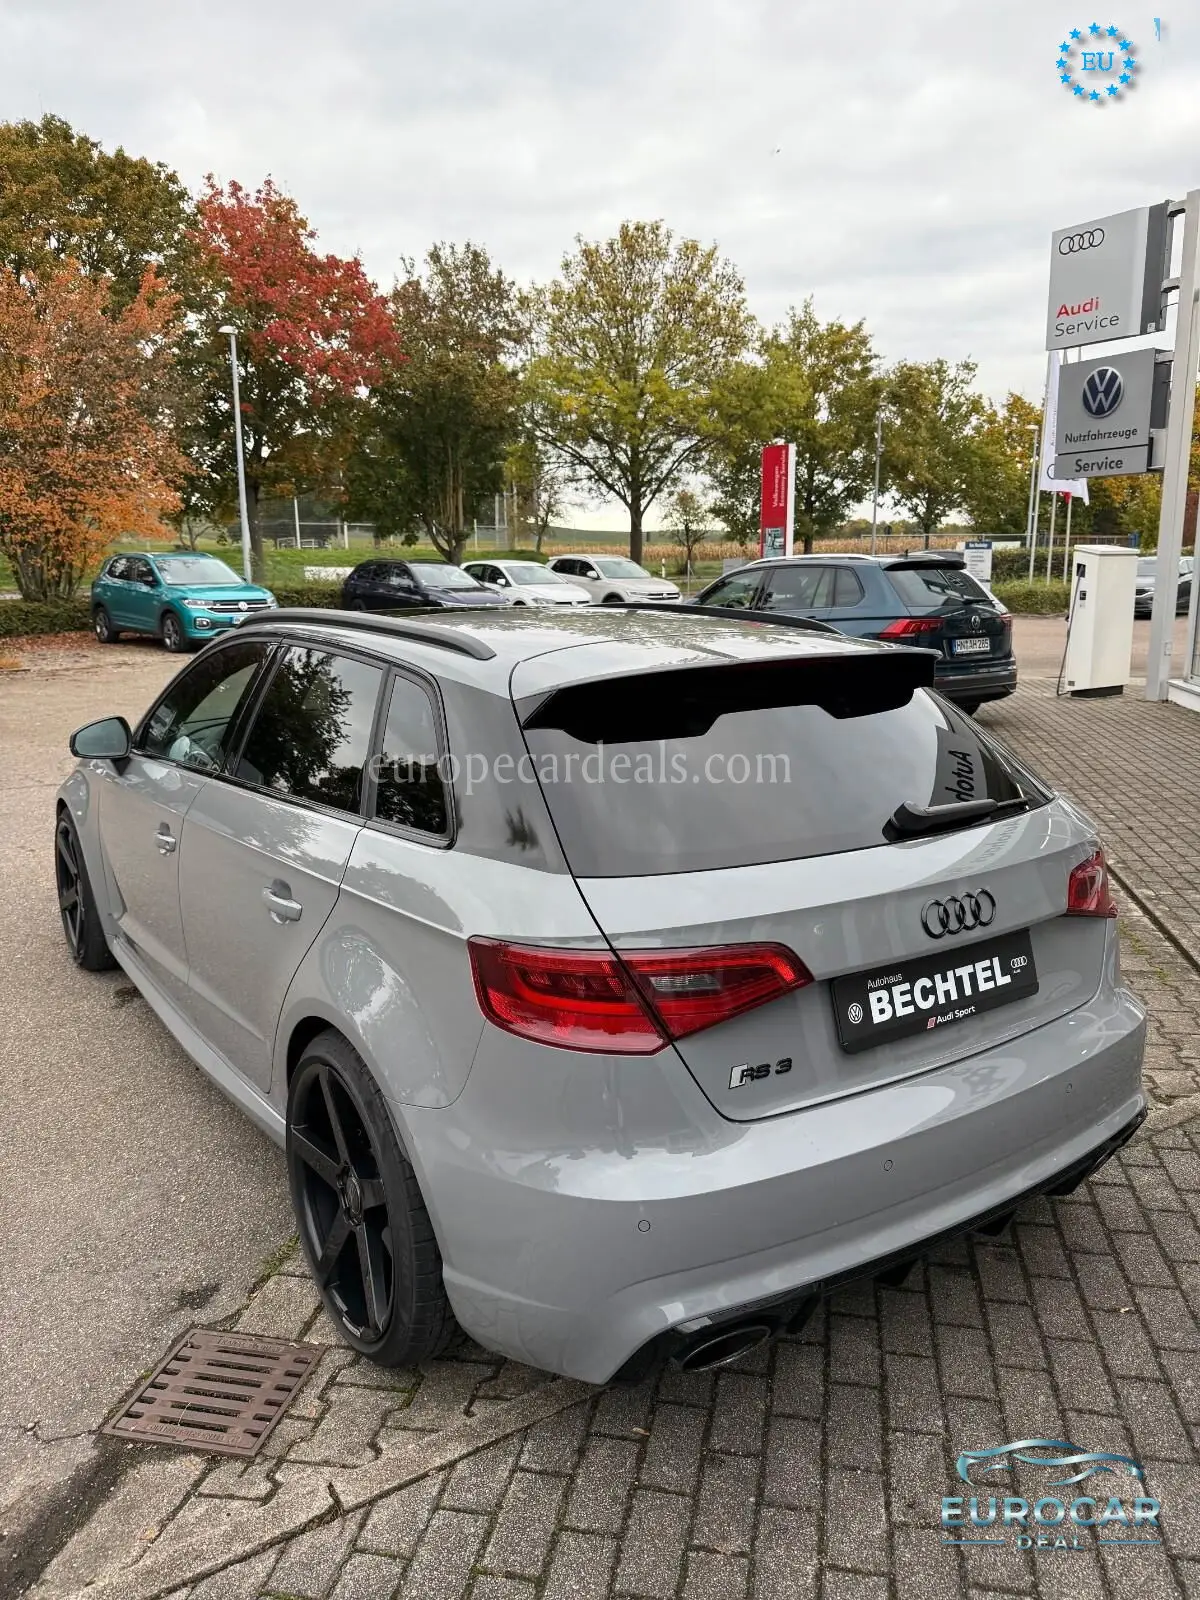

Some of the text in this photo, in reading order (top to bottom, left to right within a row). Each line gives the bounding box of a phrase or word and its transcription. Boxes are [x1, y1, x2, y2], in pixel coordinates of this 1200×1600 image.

[1056, 297, 1100, 318] Audi
[1054, 313, 1120, 337] Service
[1064, 426, 1138, 444] Nutzfahrzeuge
[1074, 456, 1124, 473] Service
[867, 973, 903, 990] Autohaus
[868, 956, 1012, 1025] BECHTEL
[936, 1005, 976, 1024] Audi Sport
[730, 1057, 793, 1088] RS 3
